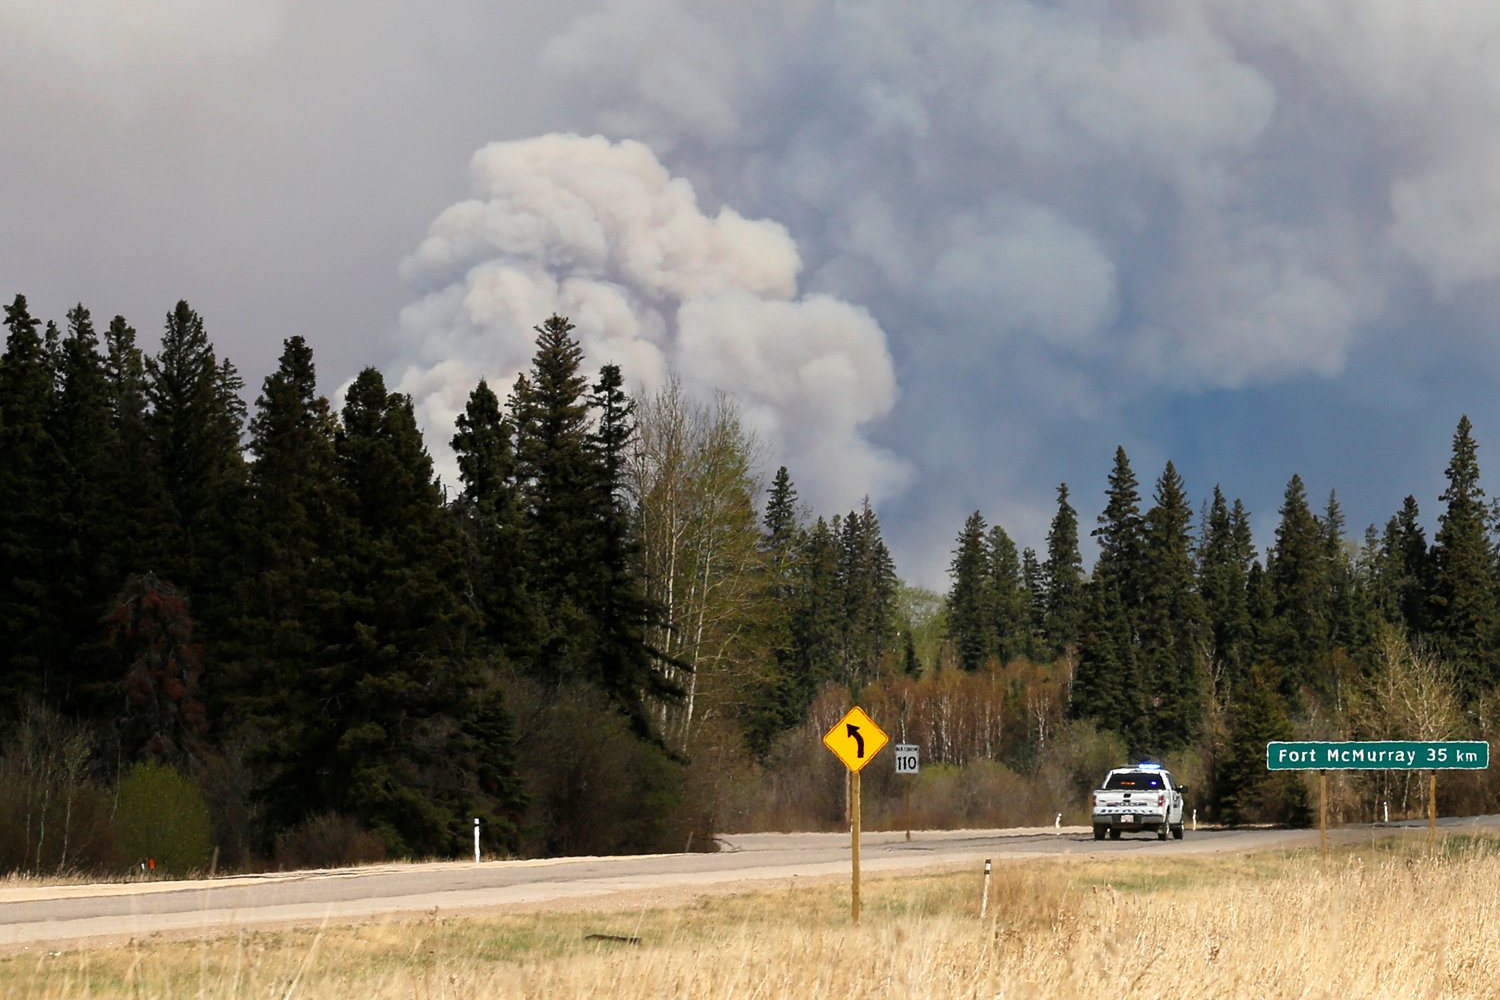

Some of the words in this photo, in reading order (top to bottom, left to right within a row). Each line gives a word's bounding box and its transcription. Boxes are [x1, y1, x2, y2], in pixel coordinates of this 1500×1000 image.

[897, 756, 917, 771] 110
[1278, 749, 1317, 762] Fort
[1327, 748, 1416, 766] McMurray
[1426, 748, 1448, 762] 35
[1456, 749, 1478, 762] km
